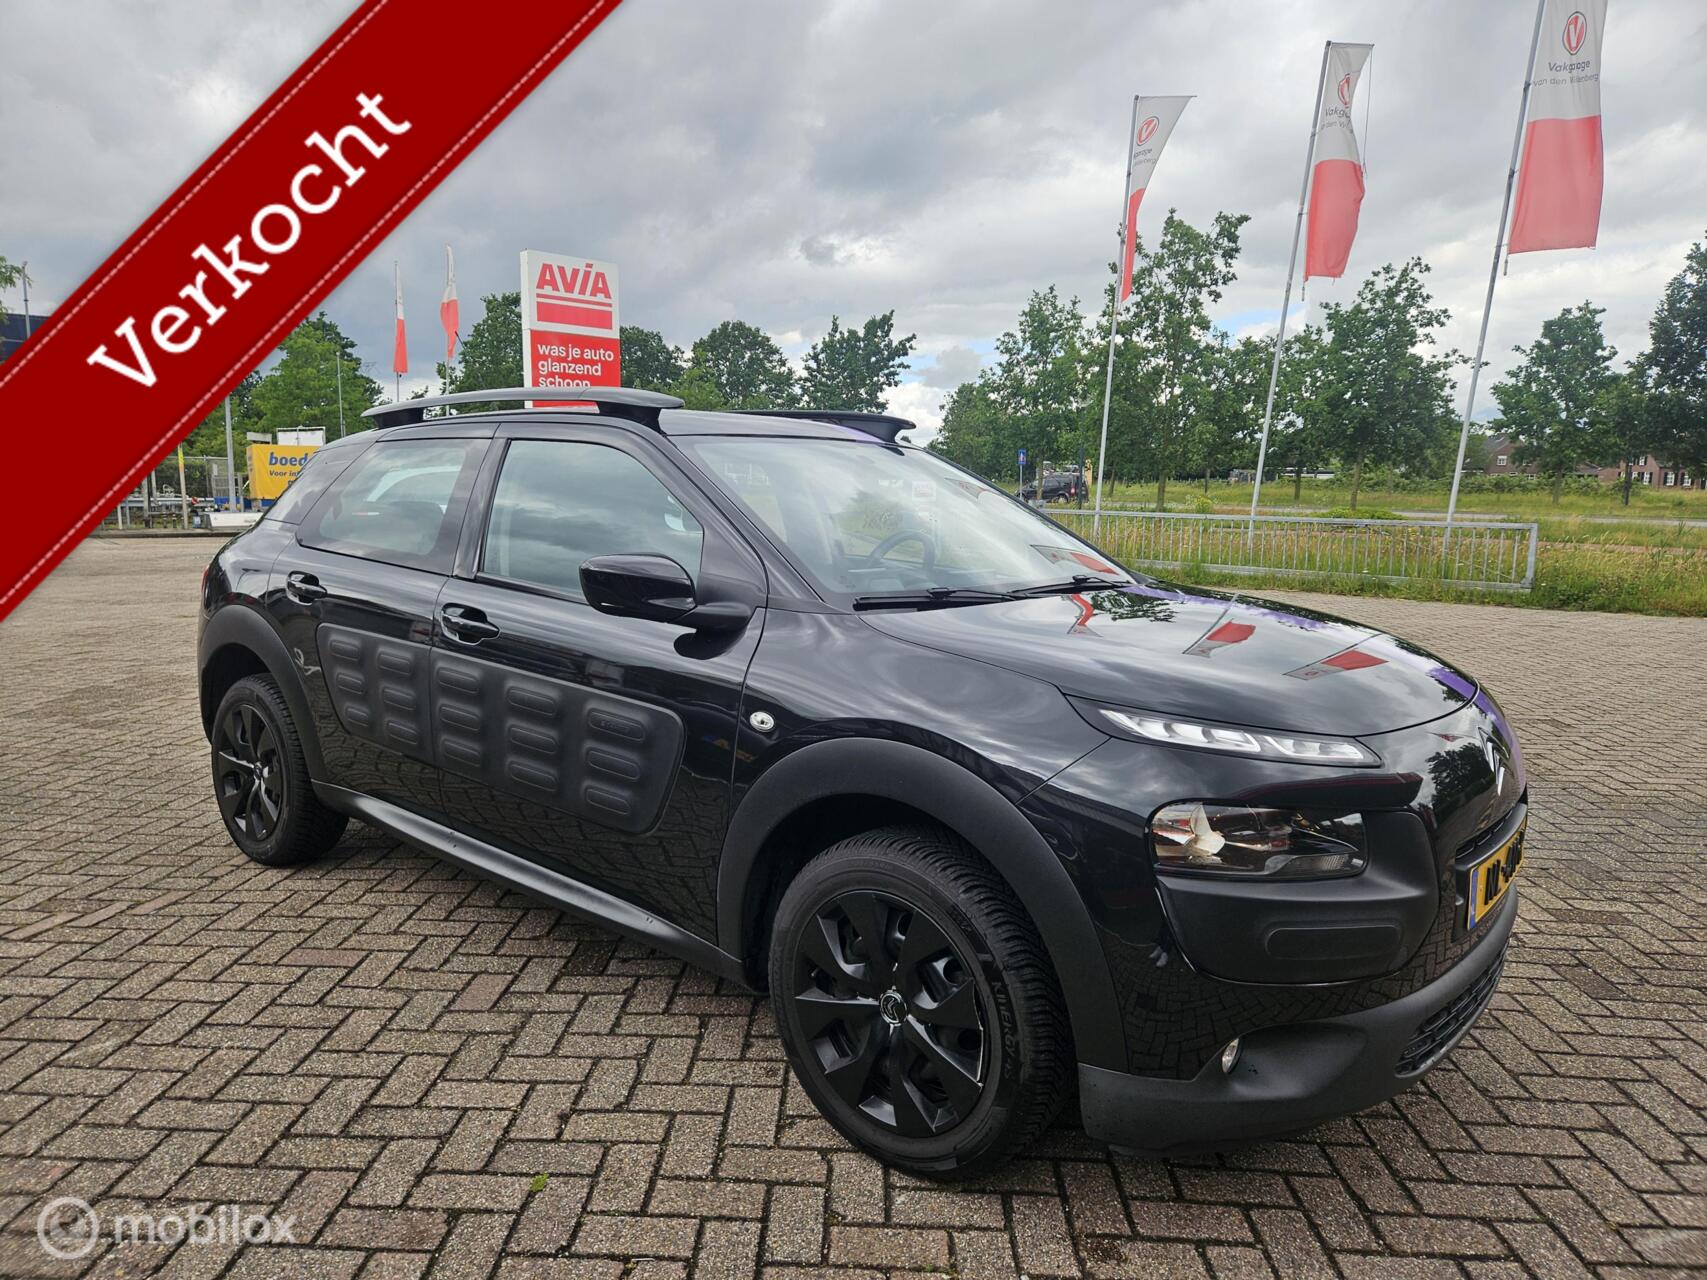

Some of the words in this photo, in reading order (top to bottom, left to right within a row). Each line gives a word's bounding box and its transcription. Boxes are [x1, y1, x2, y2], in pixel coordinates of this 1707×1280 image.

[536, 263, 612, 299] AVIA
[537, 344, 565, 356] was
[568, 344, 581, 360] je
[583, 348, 614, 361] auto
[538, 359, 602, 375] glanzend
